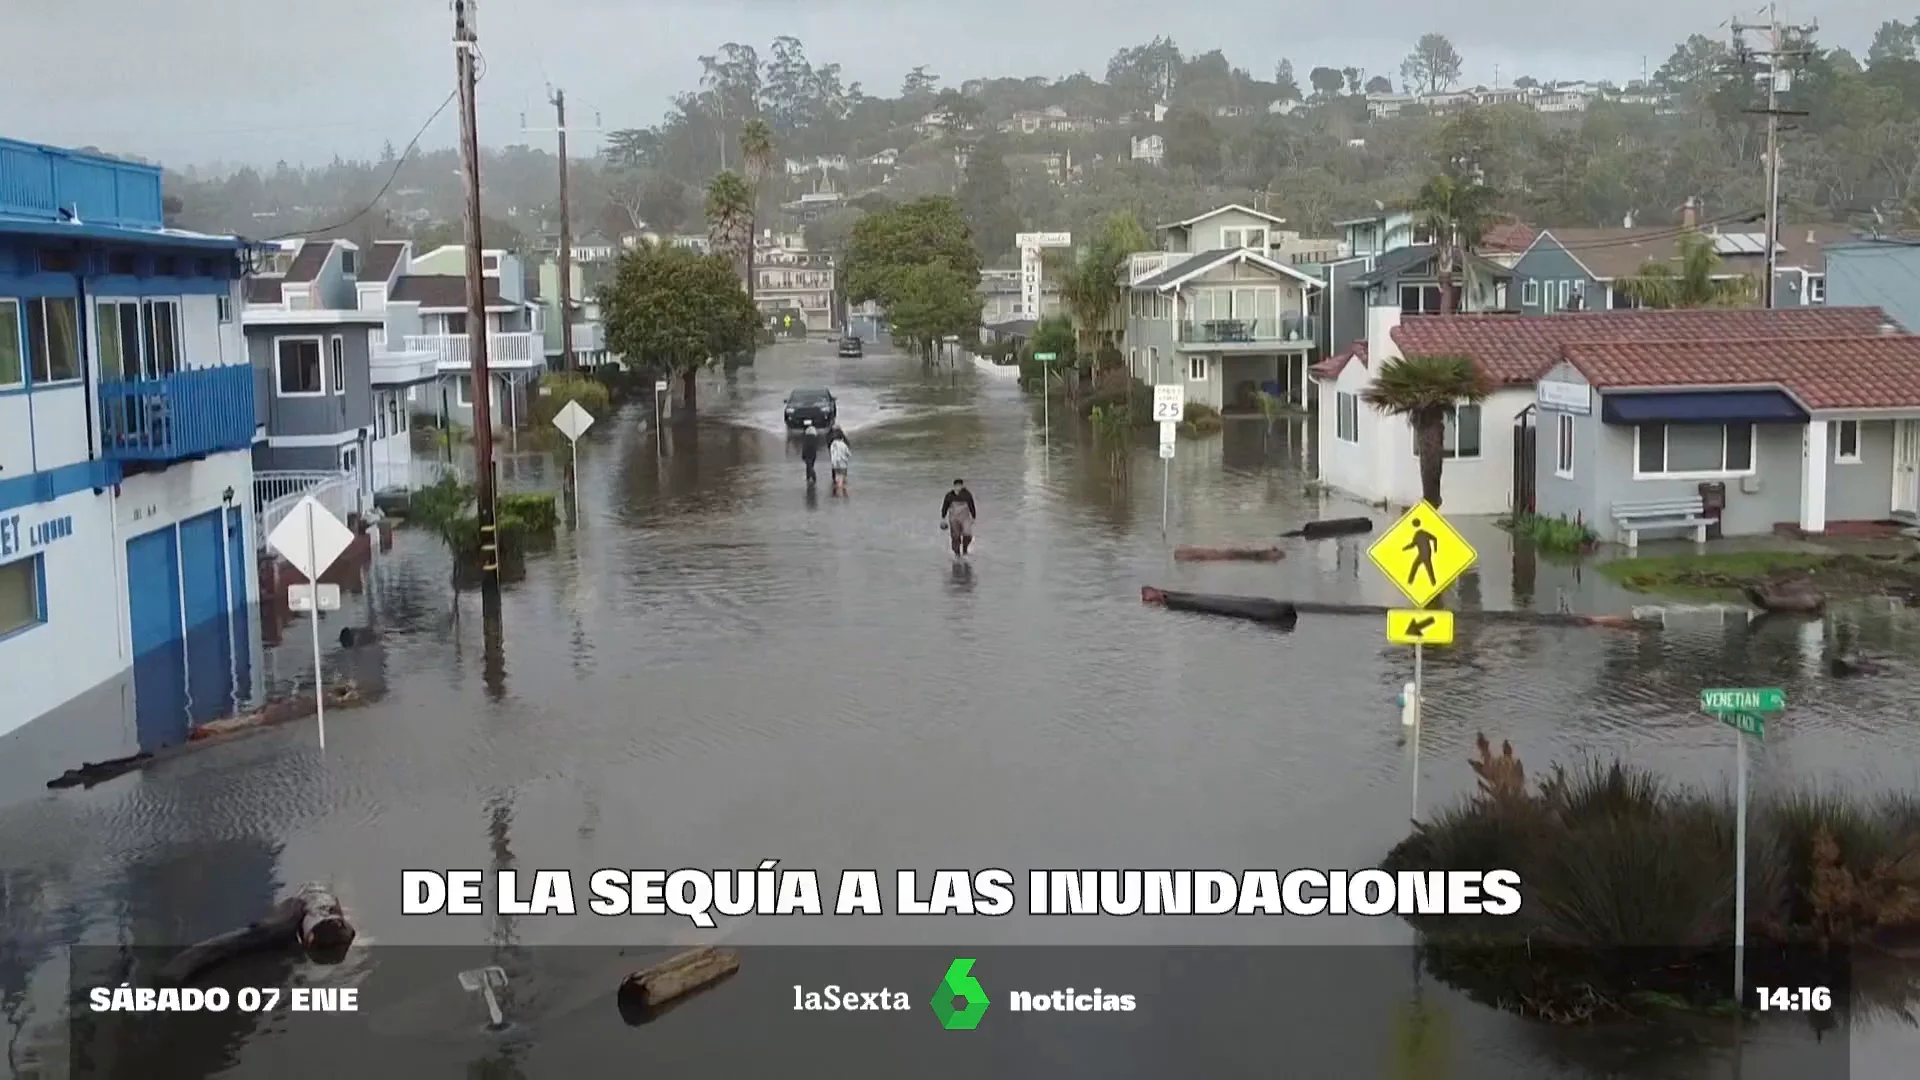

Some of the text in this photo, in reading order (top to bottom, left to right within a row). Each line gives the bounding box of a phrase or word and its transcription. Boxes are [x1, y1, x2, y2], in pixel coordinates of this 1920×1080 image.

[1158, 402, 1179, 417] 25
[0, 514, 20, 556] ET
[1705, 691, 1760, 708] VENETIAN
